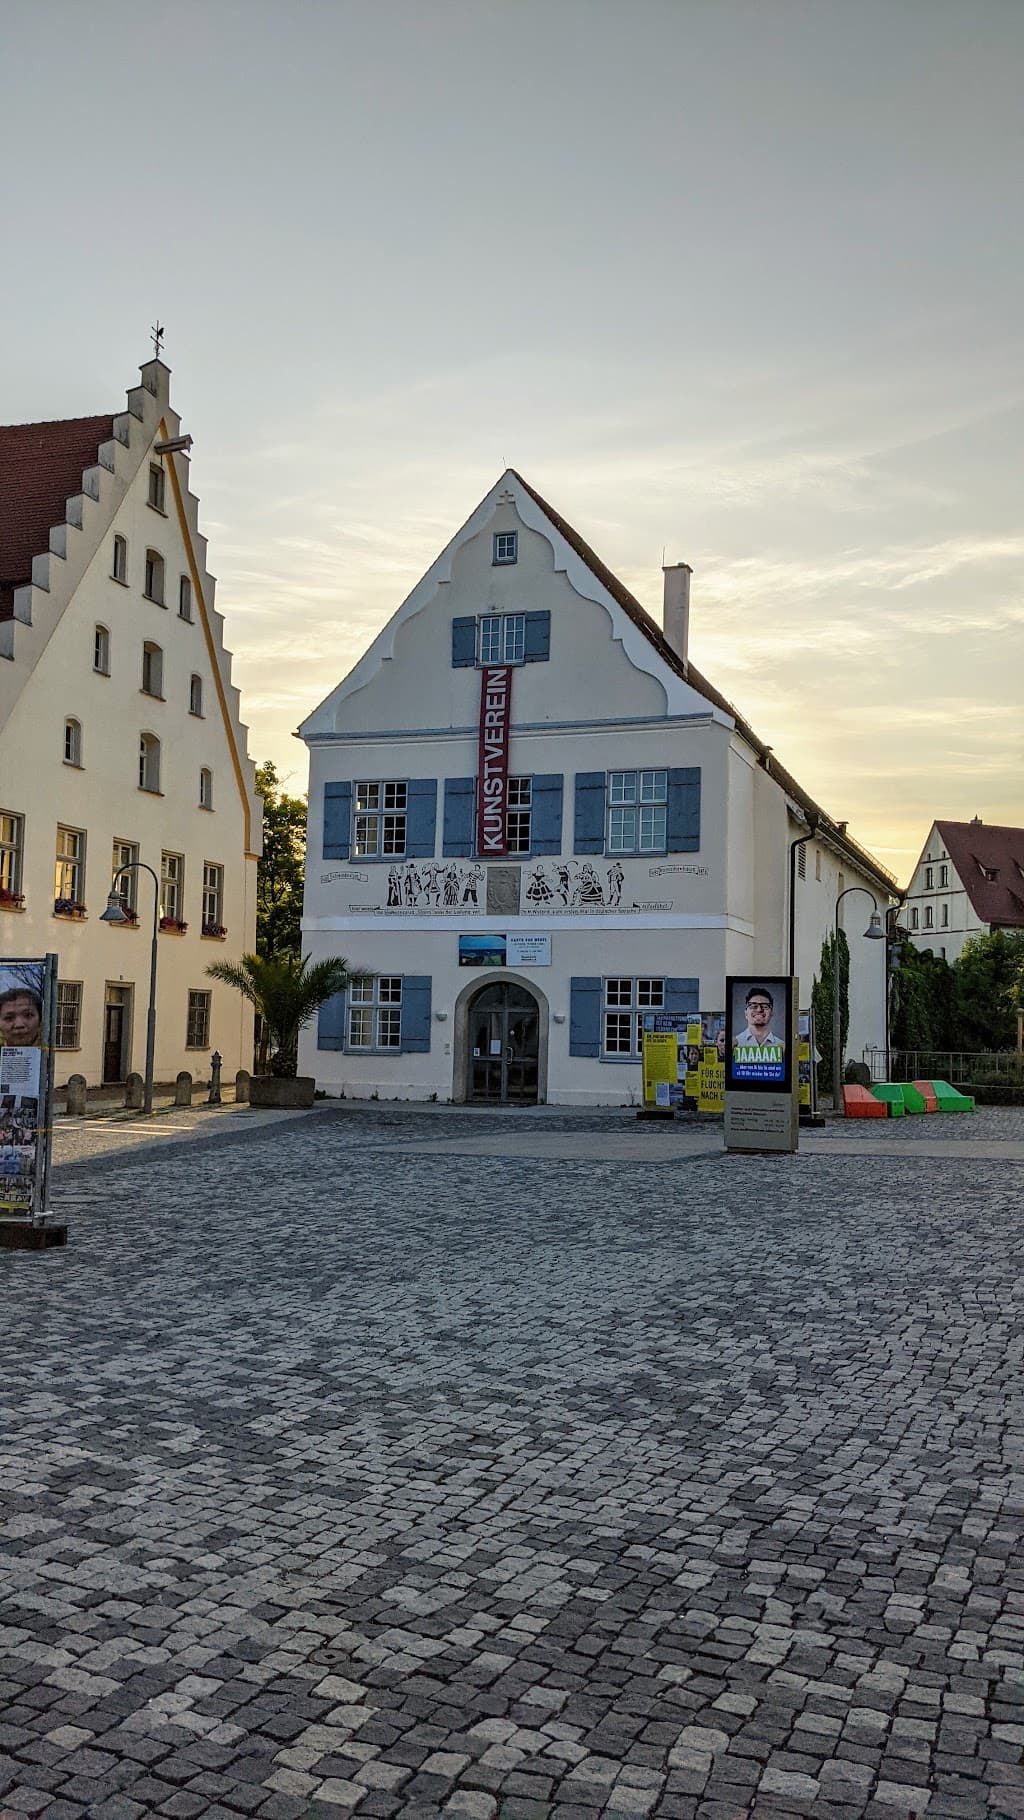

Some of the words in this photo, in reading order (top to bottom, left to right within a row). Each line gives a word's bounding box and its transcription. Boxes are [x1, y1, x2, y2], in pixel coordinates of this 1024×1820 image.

[483, 669, 507, 850] KUNSTVEREIN
[735, 1047, 781, 1062] JAAAAA!
[701, 1067, 713, 1078] FÜR
[701, 1091, 718, 1100] NACH
